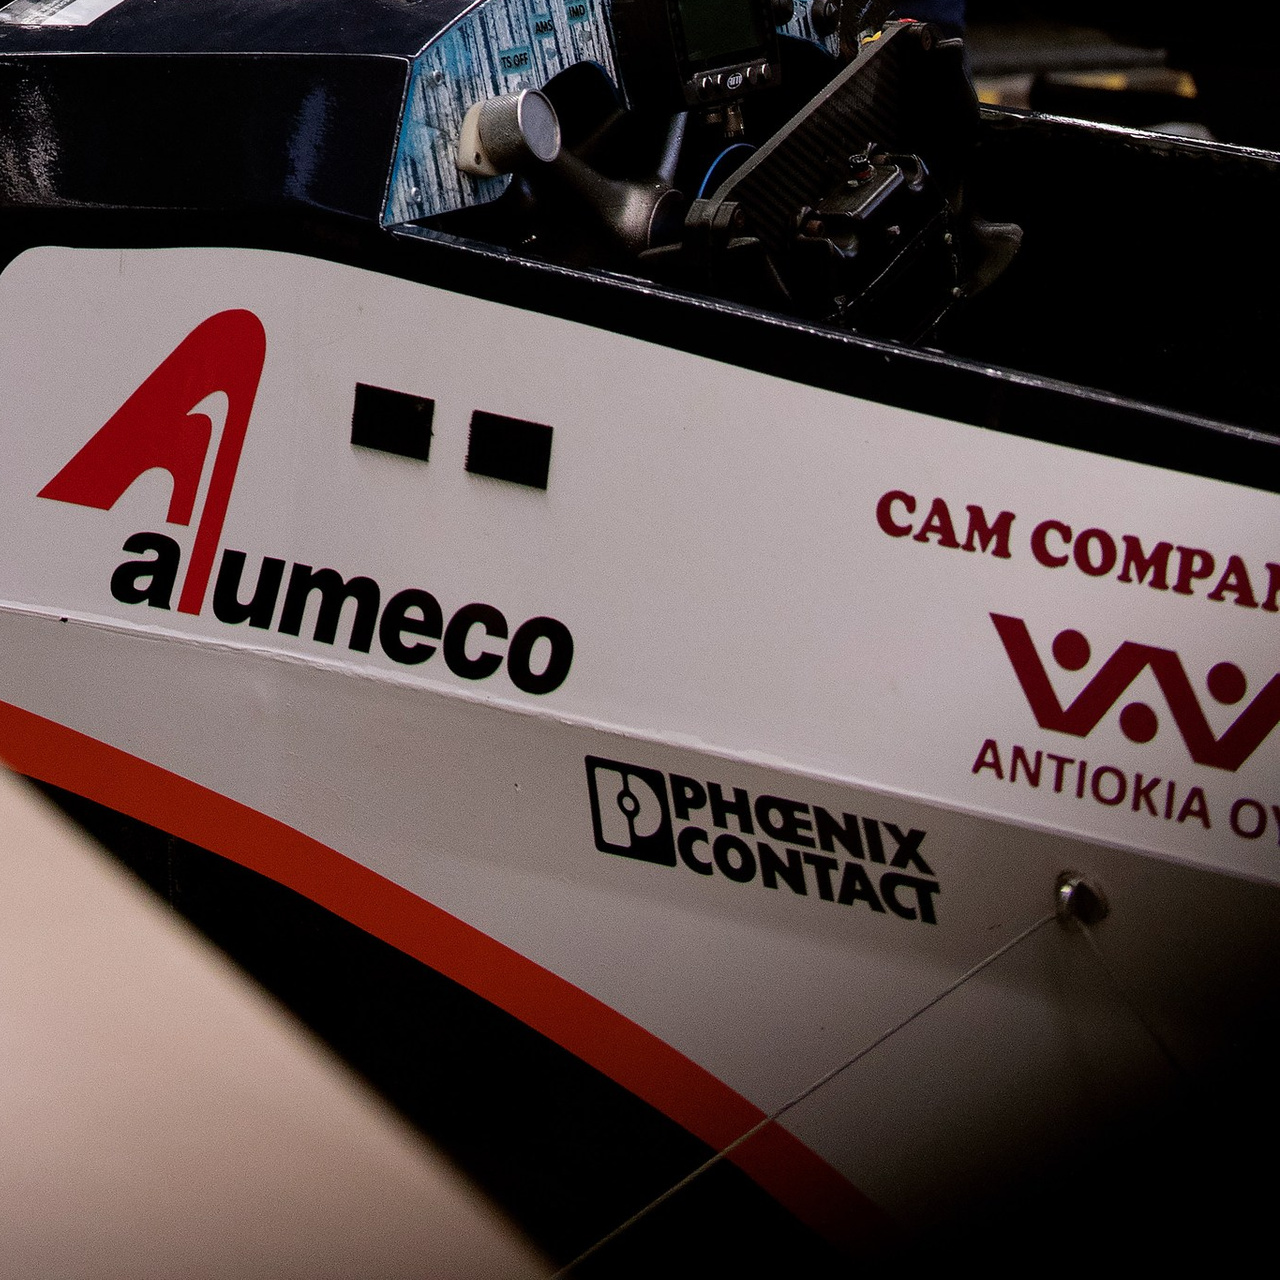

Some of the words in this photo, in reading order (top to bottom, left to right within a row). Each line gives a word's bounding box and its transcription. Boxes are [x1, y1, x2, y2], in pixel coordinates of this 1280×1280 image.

[535, 20, 554, 34] AMS
[568, 4, 586, 18] IMD
[501, 56, 512, 69] TS
[513, 52, 528, 66] OFF
[876, 490, 1016, 559] CAM
[110, 526, 574, 695] alumeco
[971, 739, 1211, 830] ANTIOKIA
[676, 826, 941, 925] CONTACT
